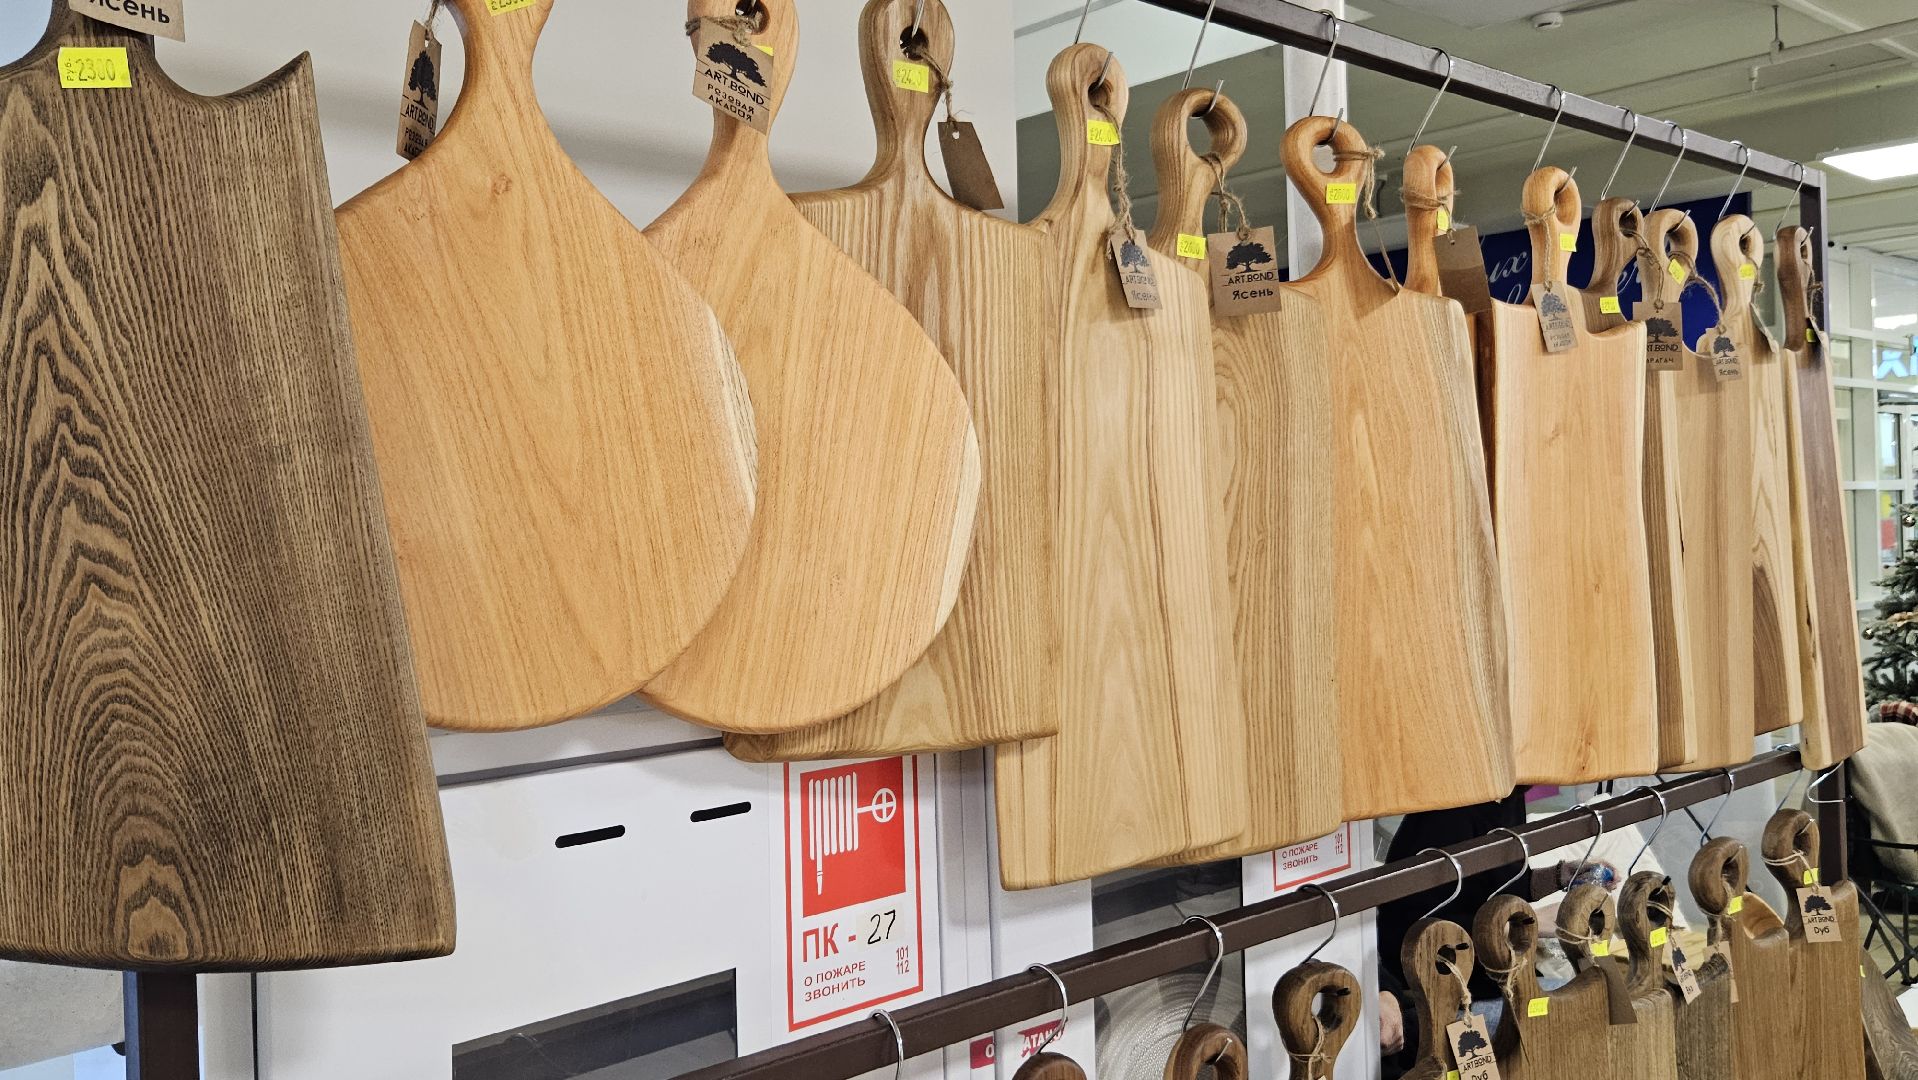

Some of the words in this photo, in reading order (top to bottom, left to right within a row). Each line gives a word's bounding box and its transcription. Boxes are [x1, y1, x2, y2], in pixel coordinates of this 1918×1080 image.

[1232, 288, 1275, 301] Ясень
[1647, 343, 1679, 352] RT.BOND
[1288, 842, 1319, 858] ПОЖАРЕ
[1282, 855, 1319, 870] ЗВОНИТЬ
[802, 922, 839, 963] ПК
[866, 908, 897, 946] 27
[895, 944, 910, 961] 101
[803, 975, 813, 988] О
[815, 959, 867, 985] ПОЖАРЕ
[896, 959, 910, 976] 112
[804, 975, 867, 1003] ЗВОНИТЬ
